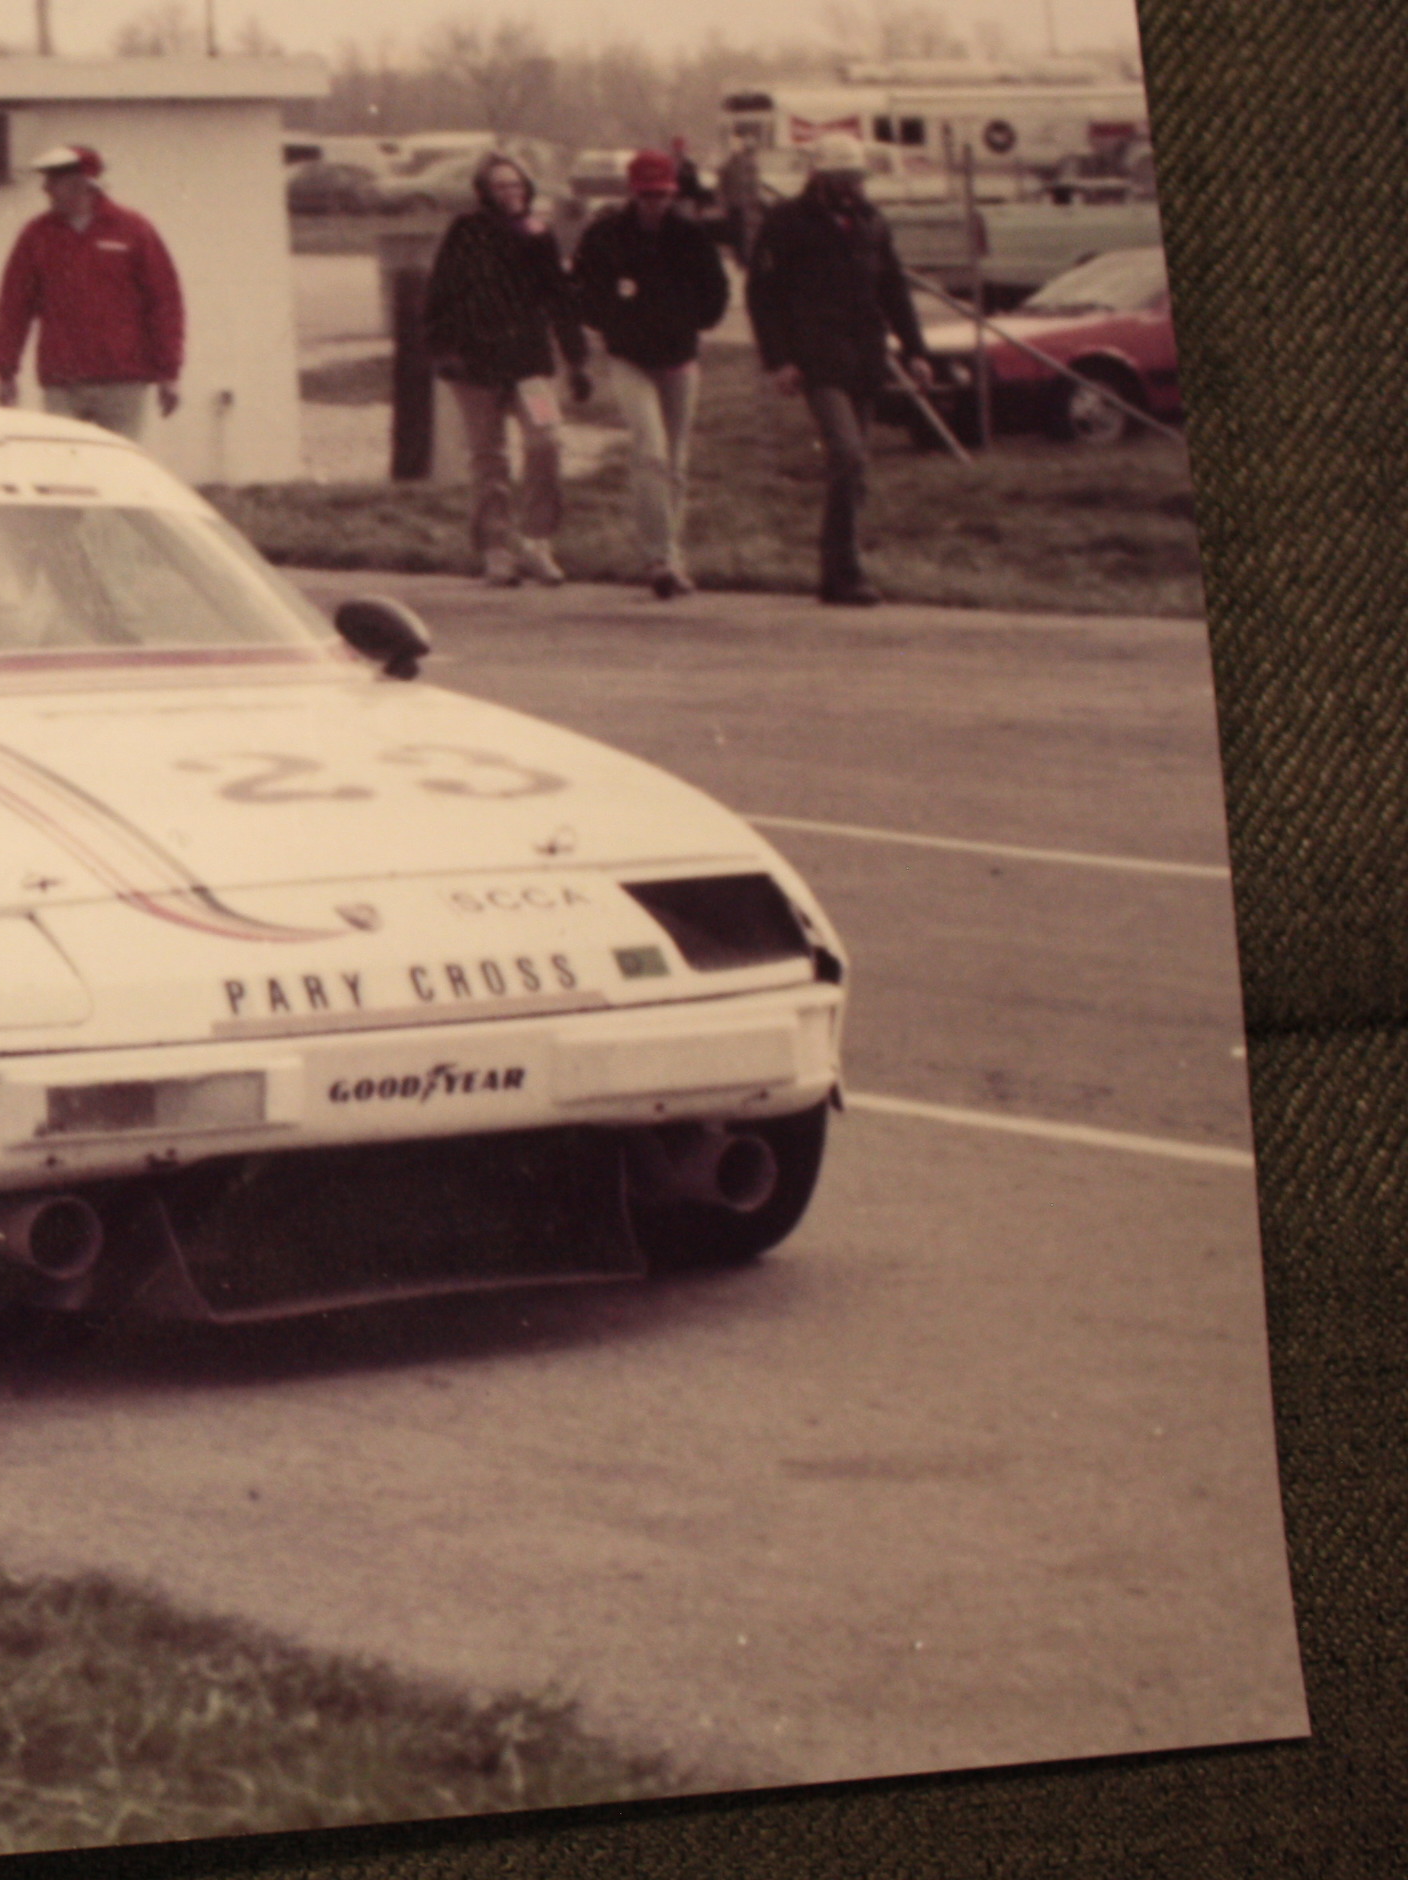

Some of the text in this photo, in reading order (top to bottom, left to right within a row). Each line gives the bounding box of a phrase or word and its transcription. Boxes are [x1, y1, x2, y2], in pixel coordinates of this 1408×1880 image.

[172, 743, 572, 801] 23
[449, 884, 592, 914] SCCA
[222, 952, 579, 1016] PARY CROSS
[328, 1062, 526, 1105] GOODYEAR
